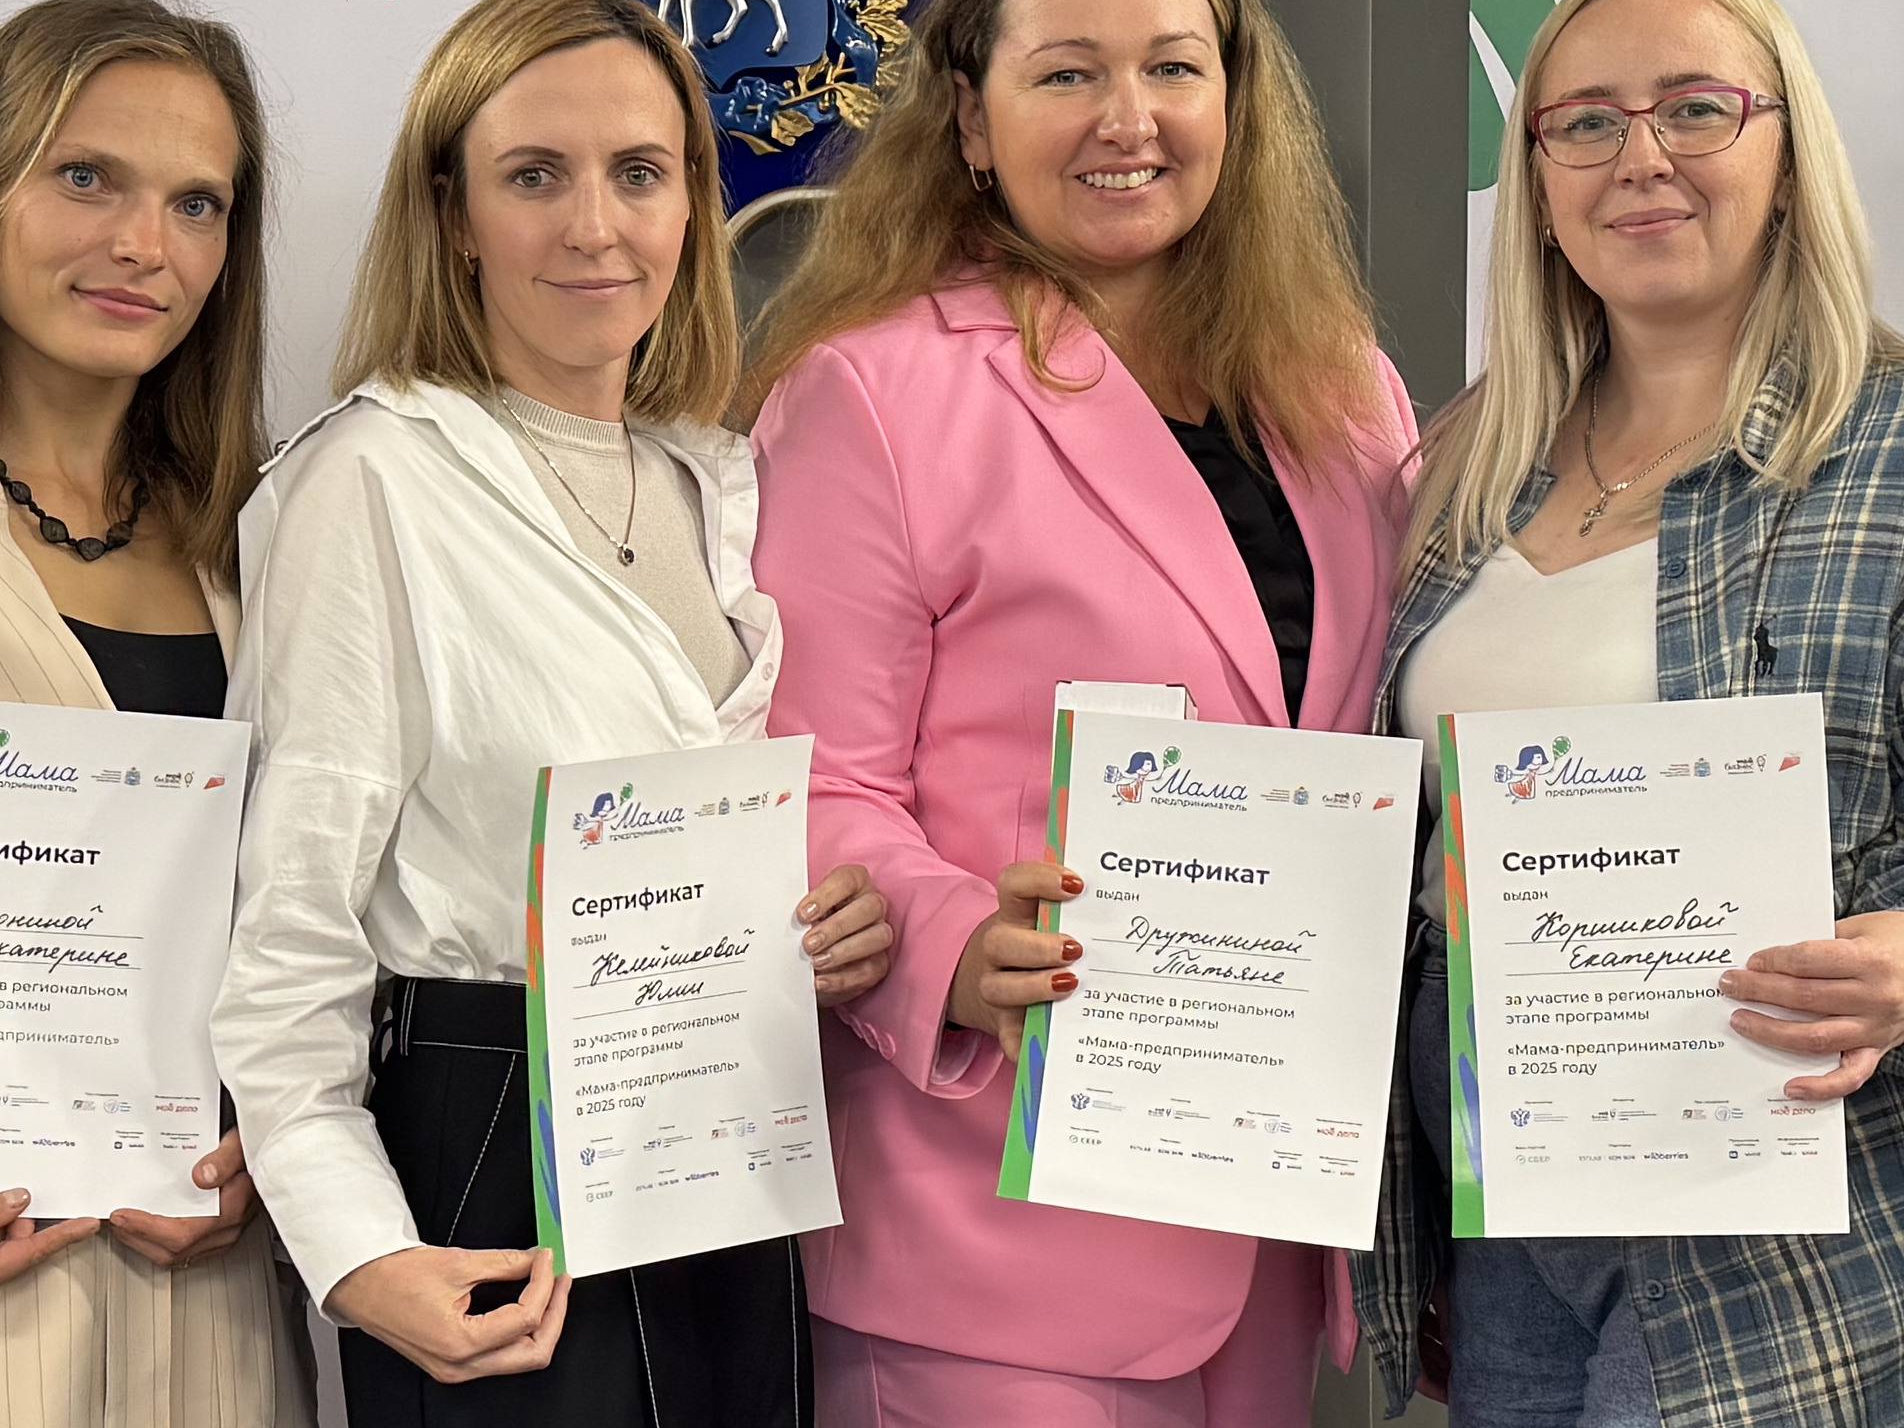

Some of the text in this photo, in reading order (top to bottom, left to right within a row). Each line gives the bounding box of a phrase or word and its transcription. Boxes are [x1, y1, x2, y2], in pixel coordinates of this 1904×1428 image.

[1152, 767, 1248, 800] Мама
[1545, 756, 1646, 786] Мама
[610, 799, 685, 831] Мама
[1099, 851, 1270, 885] Сертификат
[1502, 846, 1680, 875] Сертификат
[571, 883, 704, 918] Сертификат
[1095, 889, 1139, 901] выдан
[1502, 890, 1548, 901] выдан
[1123, 915, 1316, 959] Дружининой
[1152, 947, 1284, 984] Татьяне
[1568, 944, 1732, 982] Екатерине
[11, 982, 127, 996] региональном
[1083, 989, 1294, 1018] за участие в региональном
[1505, 995, 1521, 1005] за
[1526, 992, 1589, 1007] участие
[1594, 992, 1603, 1002] в
[1081, 1007, 1218, 1029] этапе программы
[1505, 1010, 1649, 1025] этапе программы
[1075, 1052, 1161, 1074] в 2025 году
[1507, 1061, 1597, 1075] в 2025 году
[586, 1098, 615, 1114] 2025
